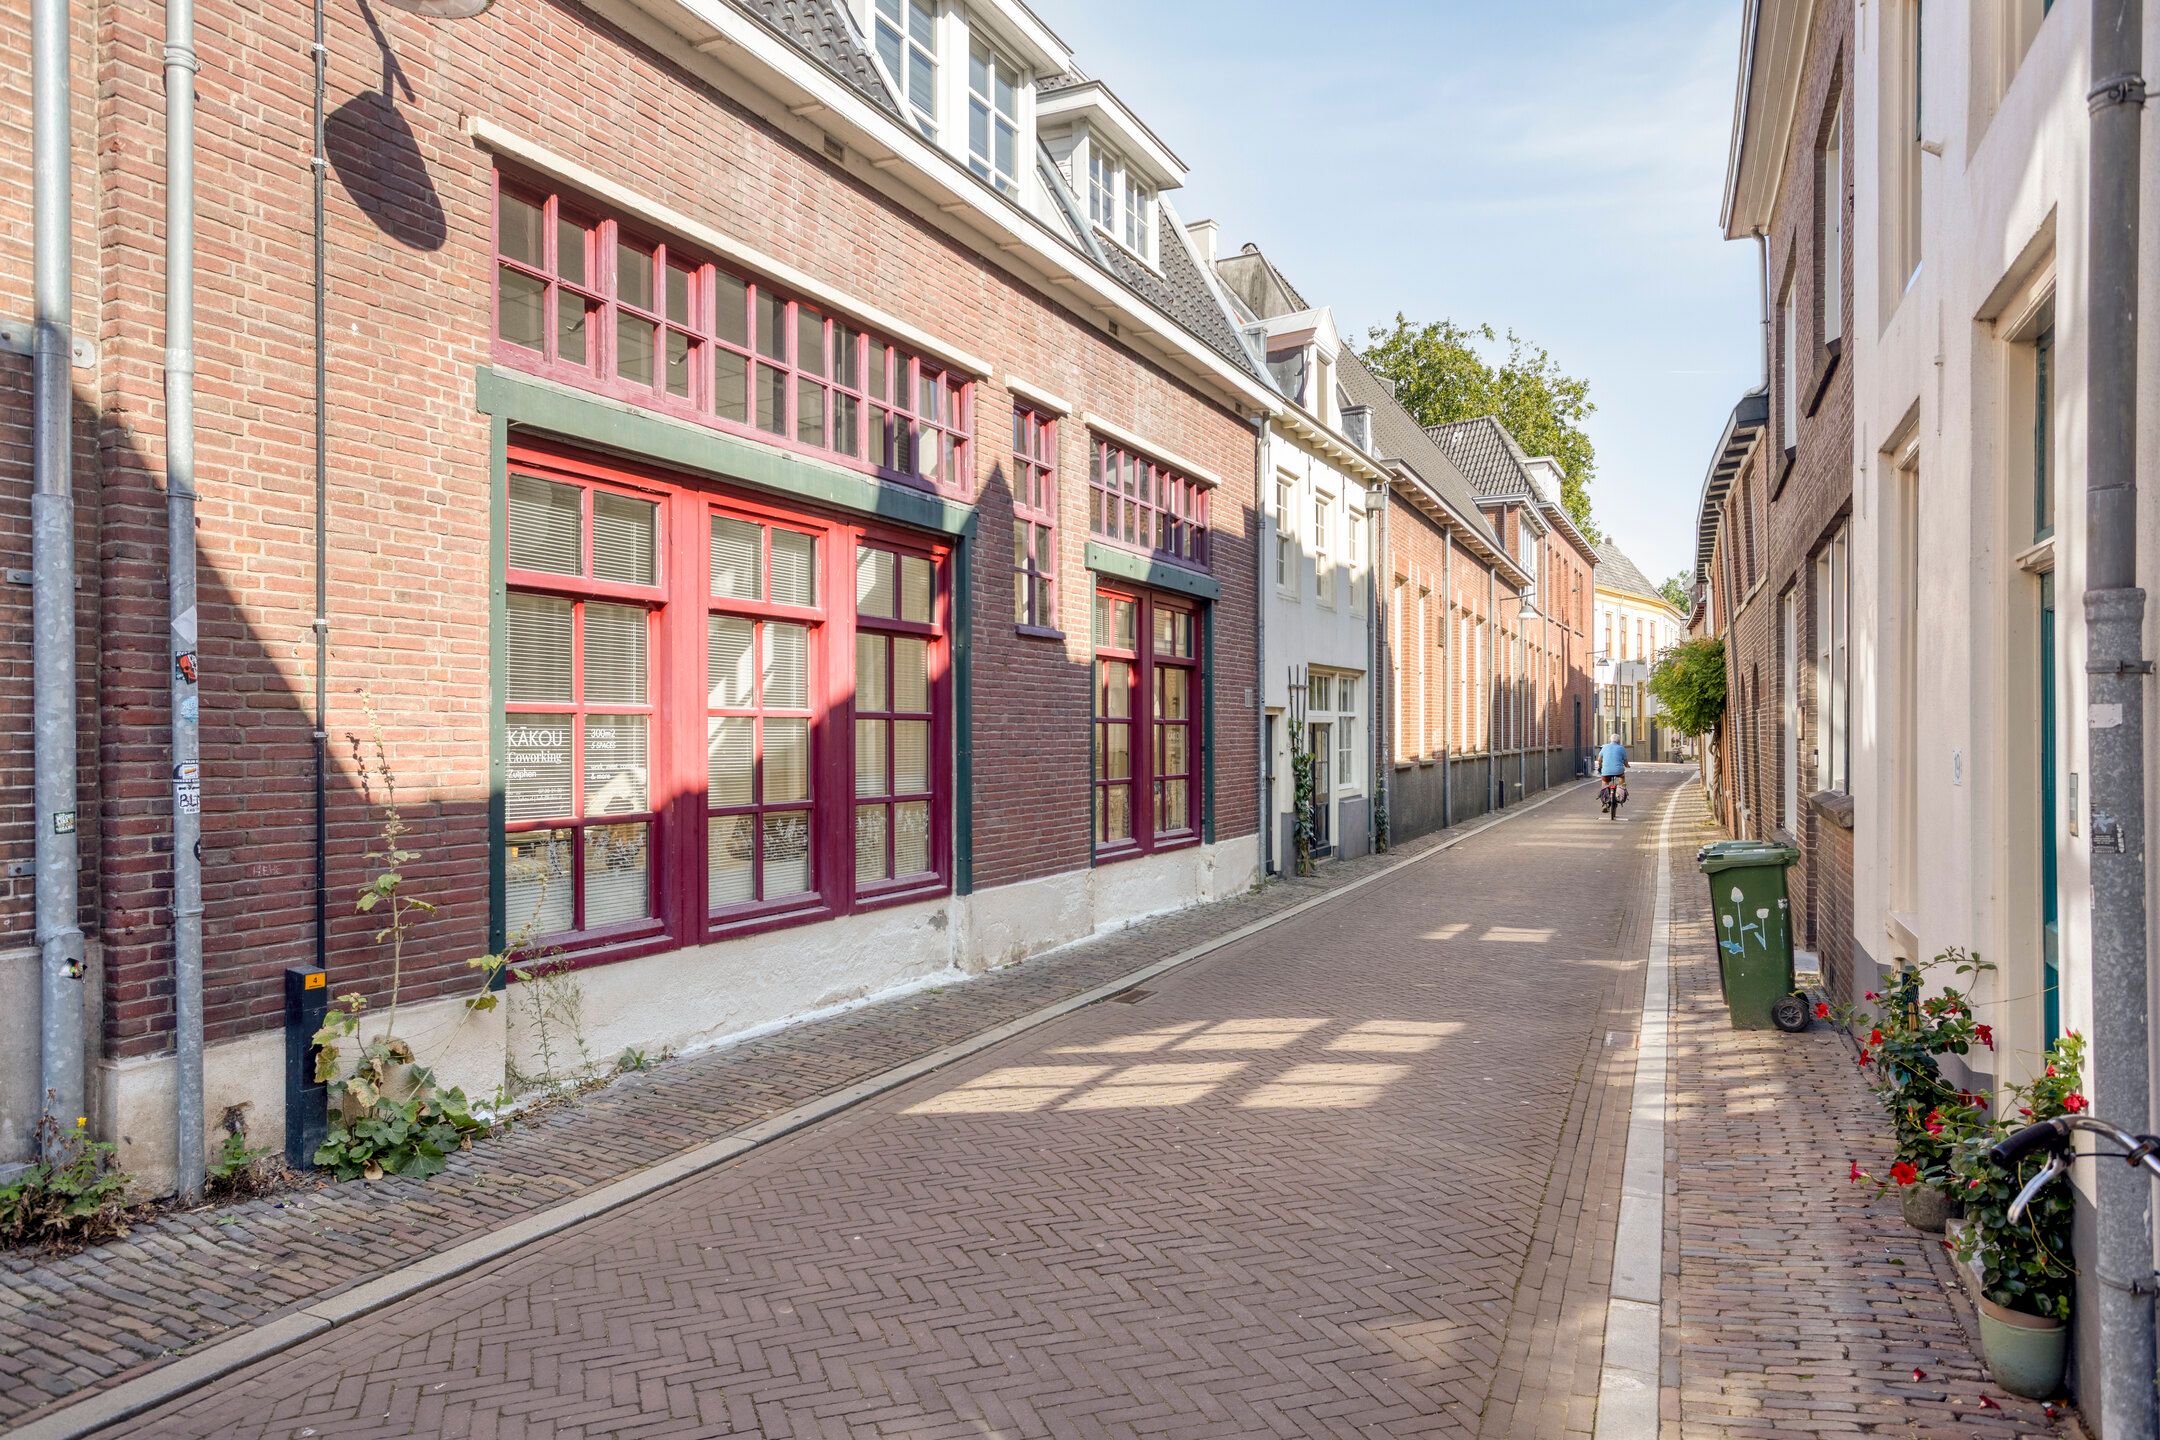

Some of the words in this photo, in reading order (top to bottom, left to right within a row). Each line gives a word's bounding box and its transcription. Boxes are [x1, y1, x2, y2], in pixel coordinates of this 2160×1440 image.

[508, 750, 562, 765] Coworking
[508, 768, 537, 780] Zutphen
[312, 976, 318, 984] 4
